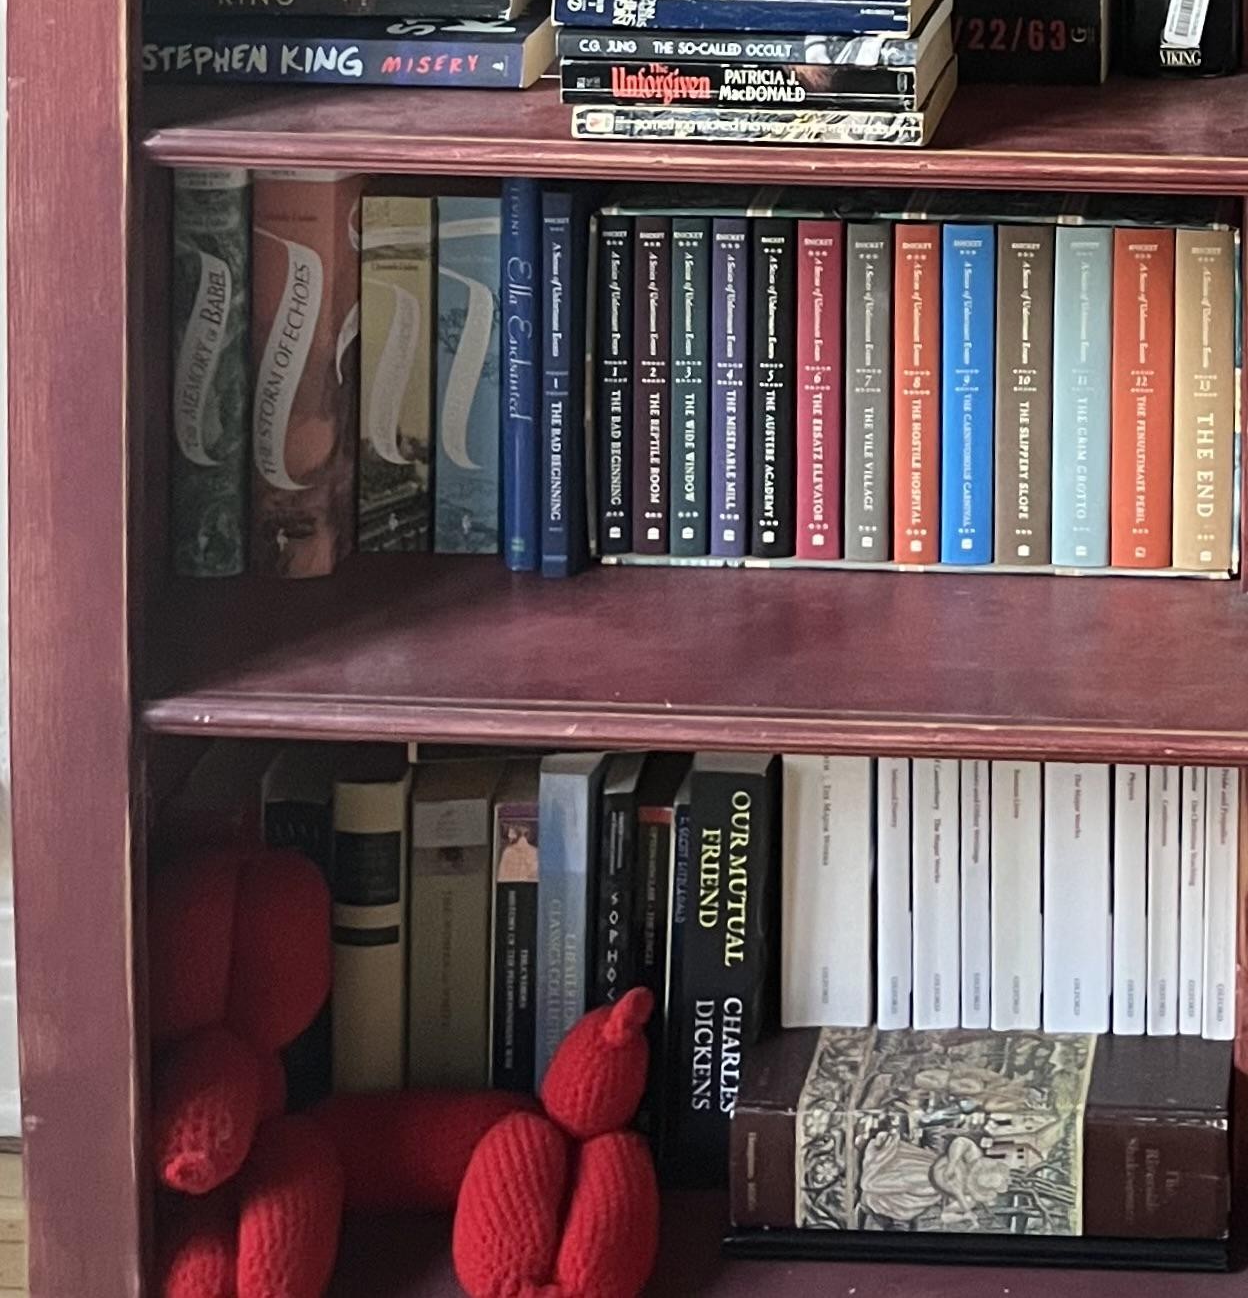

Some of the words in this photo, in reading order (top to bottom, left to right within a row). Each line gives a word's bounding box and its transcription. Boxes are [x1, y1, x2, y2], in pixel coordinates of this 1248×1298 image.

[142, 44, 268, 74] STEPHEN
[280, 44, 363, 76] KING
[381, 55, 479, 73] MISERY
[724, 69, 784, 85] PATRICIA
[611, 67, 710, 105] Unforgiven
[719, 86, 805, 102] MacDONALD
[1197, 413, 1214, 459] THE
[1197, 470, 1214, 517] END
[731, 790, 752, 846] OUR
[699, 828, 722, 929] FRIEND
[724, 853, 748, 967] MUTUAL
[691, 1000, 714, 1110] DICKENS
[720, 997, 743, 1120] CHARLES
